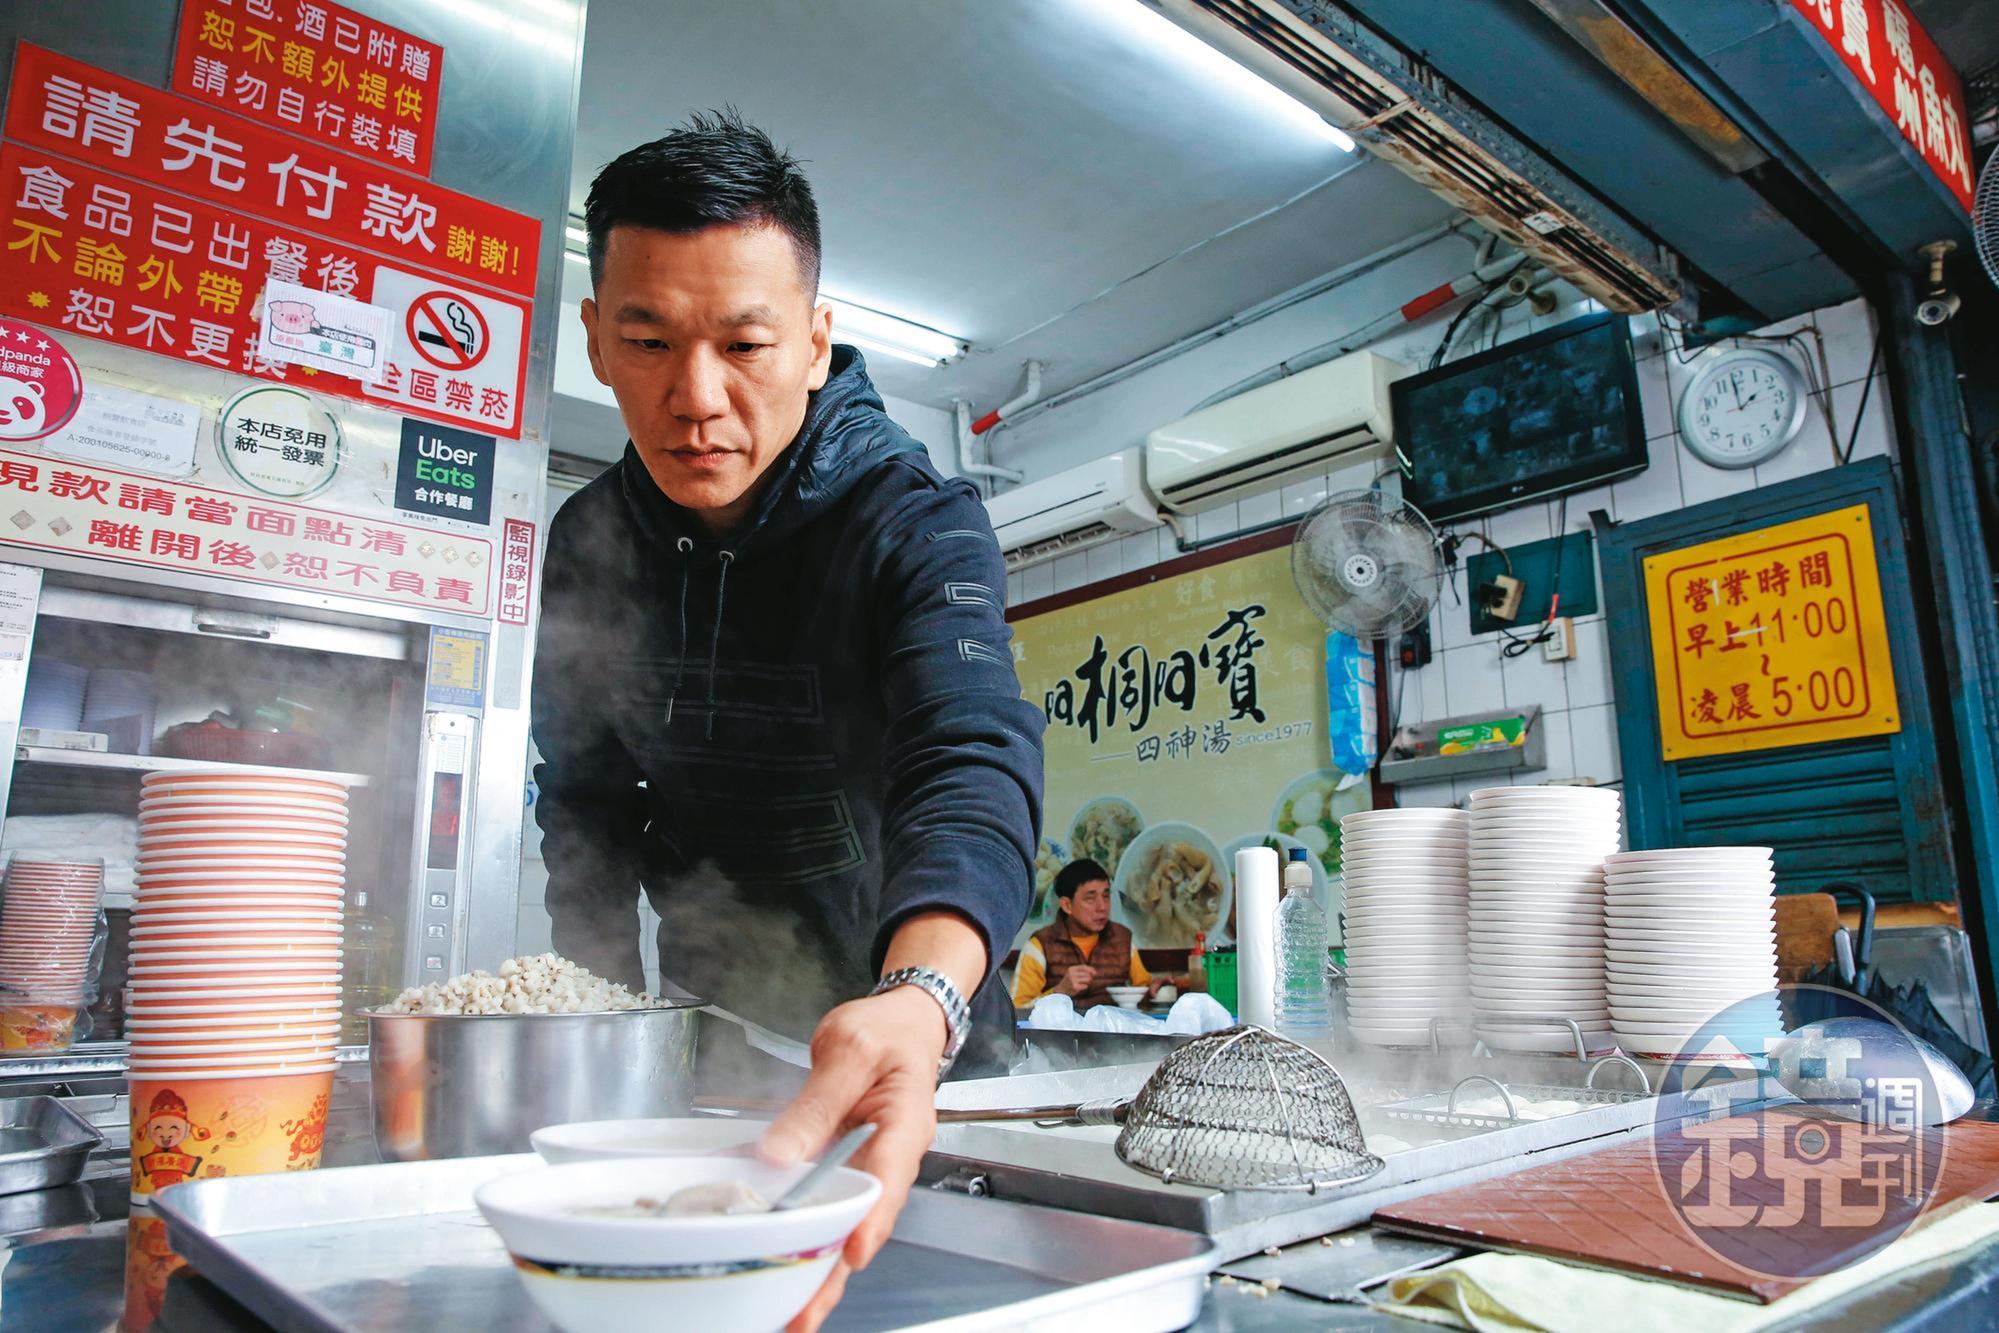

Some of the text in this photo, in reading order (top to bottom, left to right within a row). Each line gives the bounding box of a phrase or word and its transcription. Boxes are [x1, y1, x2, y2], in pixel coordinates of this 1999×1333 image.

[199, 9, 423, 123] 恕不額外提供
[192, 55, 418, 165] 請勿自行裝填
[43, 75, 437, 254] 請先付款
[15, 165, 360, 299] 食品已出餐後
[0, 361, 45, 379] 級商家
[371, 360, 509, 421] 全區禁菸
[234, 436, 325, 468] 統一發票
[236, 417, 327, 449] 本店免用
[417, 436, 478, 467] Uber
[414, 487, 474, 511] 合作餐廳
[415, 458, 476, 490] Eats
[0, 460, 408, 557] 現款請當面點清
[503, 525, 530, 621] 監視錄影中
[1684, 551, 1832, 614] 營業時間
[1136, 720, 1232, 762] 四神湯
